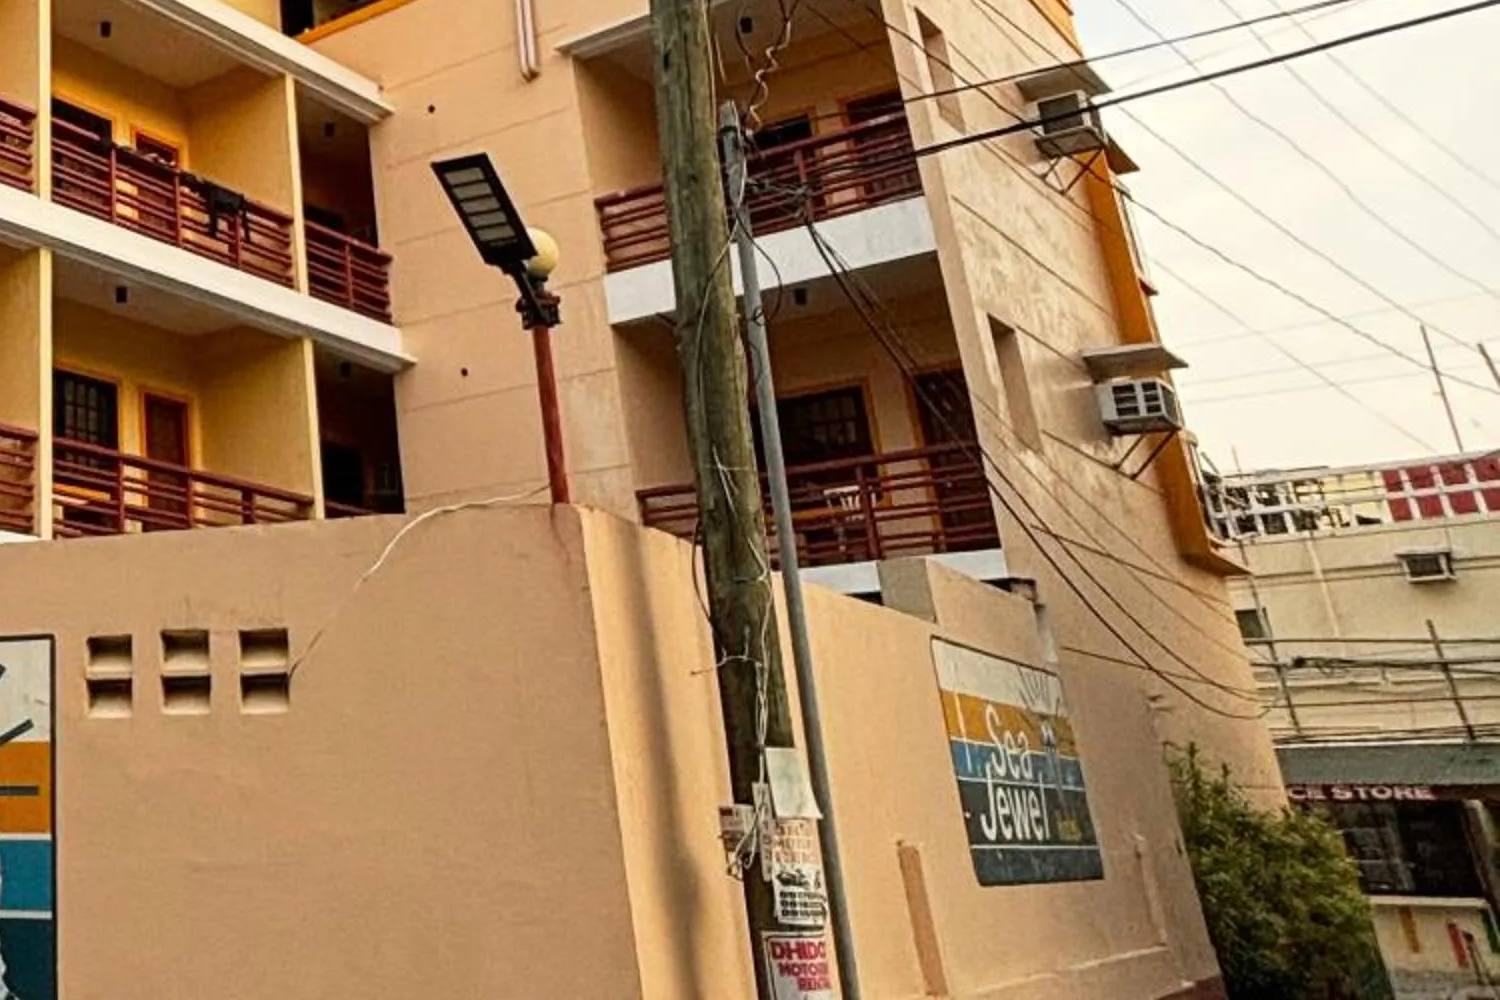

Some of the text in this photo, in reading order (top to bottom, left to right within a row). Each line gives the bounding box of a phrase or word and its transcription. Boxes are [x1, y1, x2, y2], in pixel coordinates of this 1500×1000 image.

[985, 703, 1033, 779] Sea
[980, 761, 1051, 841] Jewel
[1331, 785, 1436, 800] STORE
